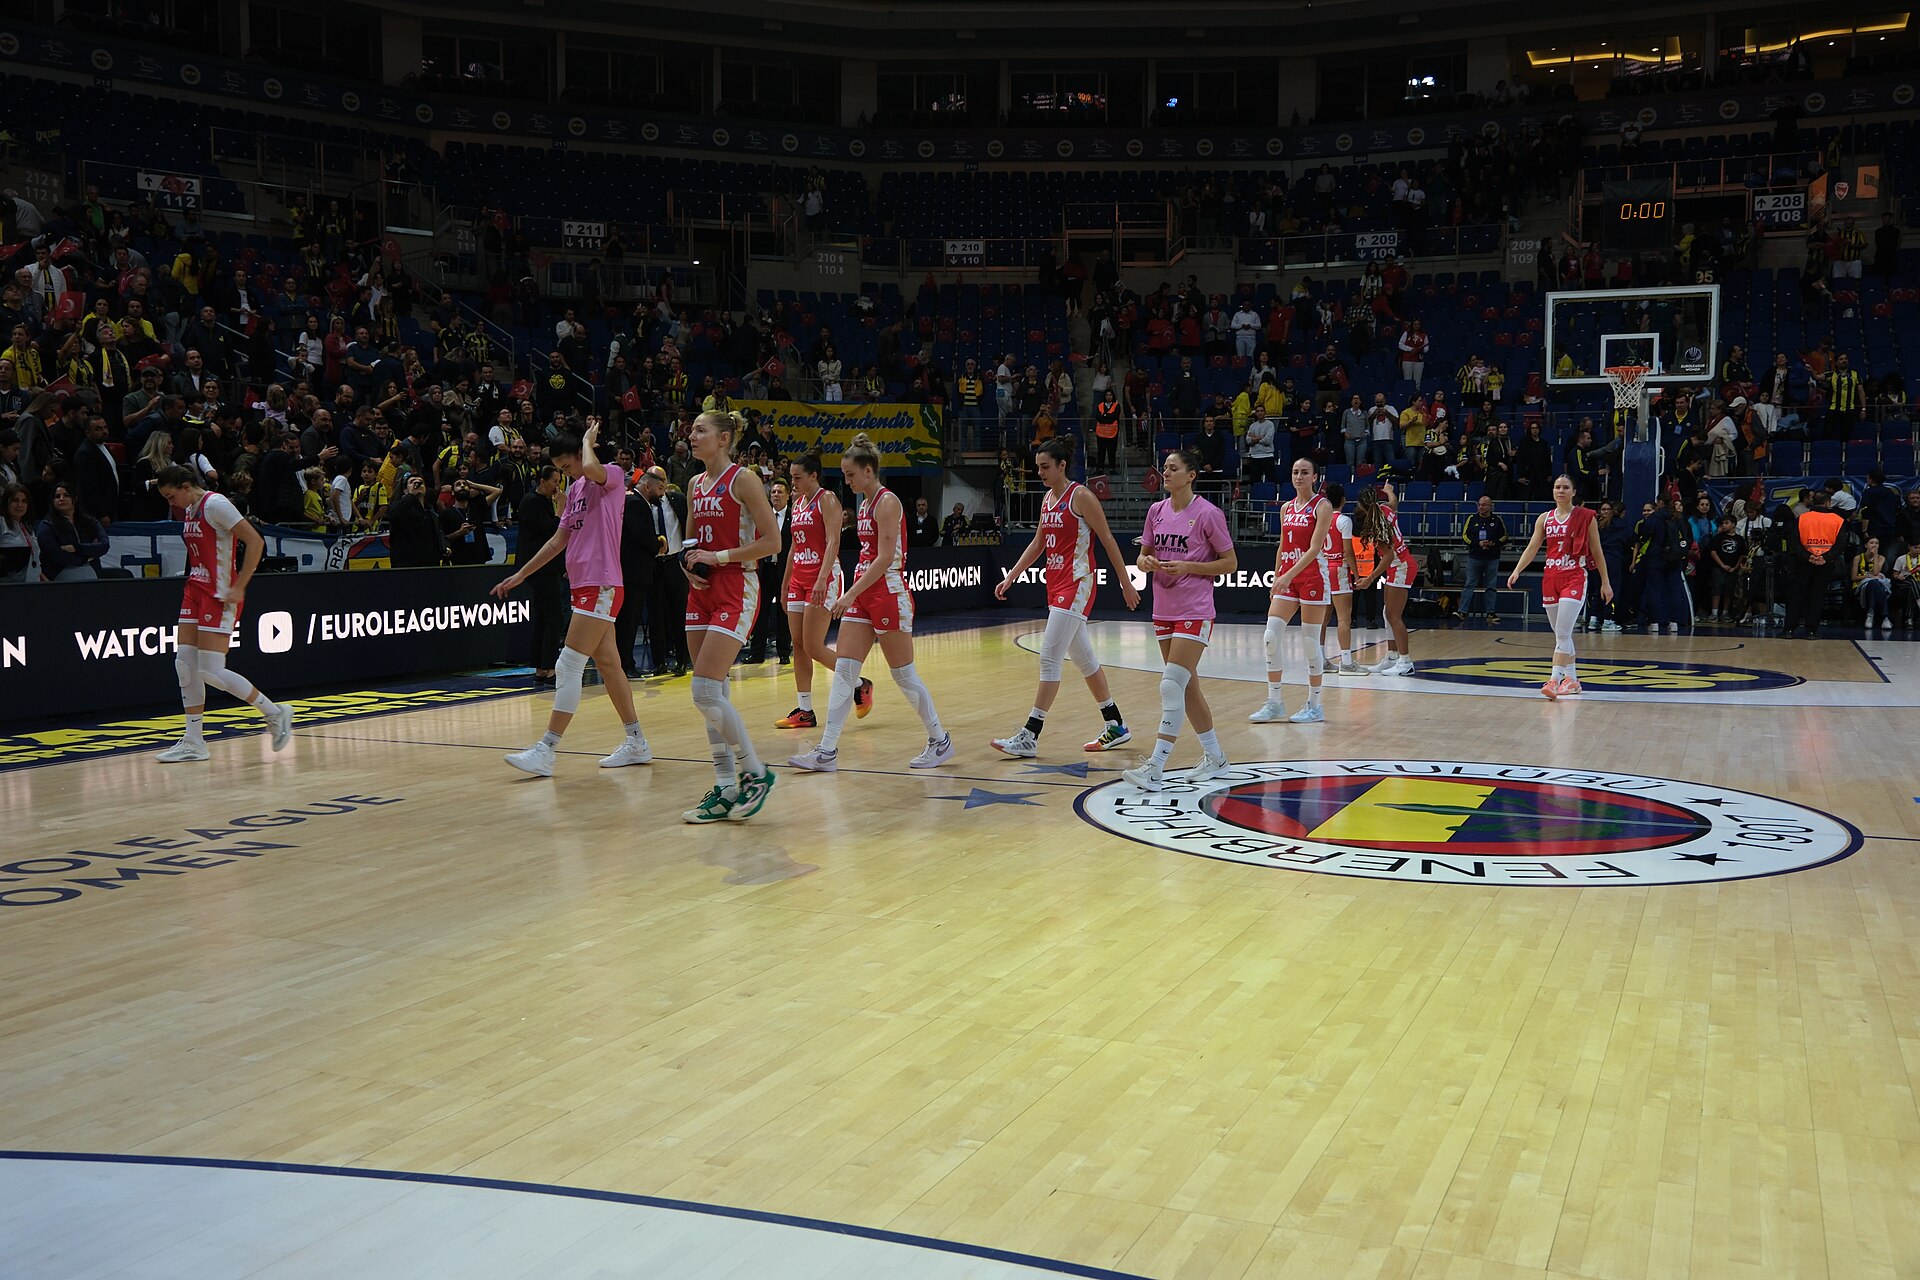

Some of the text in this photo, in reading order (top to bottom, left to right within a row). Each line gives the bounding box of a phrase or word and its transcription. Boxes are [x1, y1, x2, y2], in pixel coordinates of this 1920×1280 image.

[25, 170, 48, 186] 212
[25, 186, 48, 201] 112
[162, 194, 196, 209] 112
[1771, 196, 1802, 208] 208
[1620, 202, 1665, 220] 0:00
[1771, 210, 1802, 223] 108
[577, 224, 602, 236] 211
[578, 237, 602, 250] 111
[961, 242, 980, 252] 210
[1371, 235, 1396, 246] 209
[1511, 240, 1532, 252] 209
[817, 253, 837, 265] 210
[1371, 247, 1396, 259] 109
[961, 255, 980, 265] 110
[817, 265, 837, 276] 110
[698, 524, 713, 543] 18
[1546, 524, 1568, 535] DVT
[793, 530, 807, 544] 33
[1045, 533, 1056, 549] 20
[1154, 533, 1190, 548] DVTK
[0, 794, 407, 882] OLEAGUE
[1115, 796, 1641, 880] FENERBAHÇE
[1721, 813, 1814, 853] 1907
